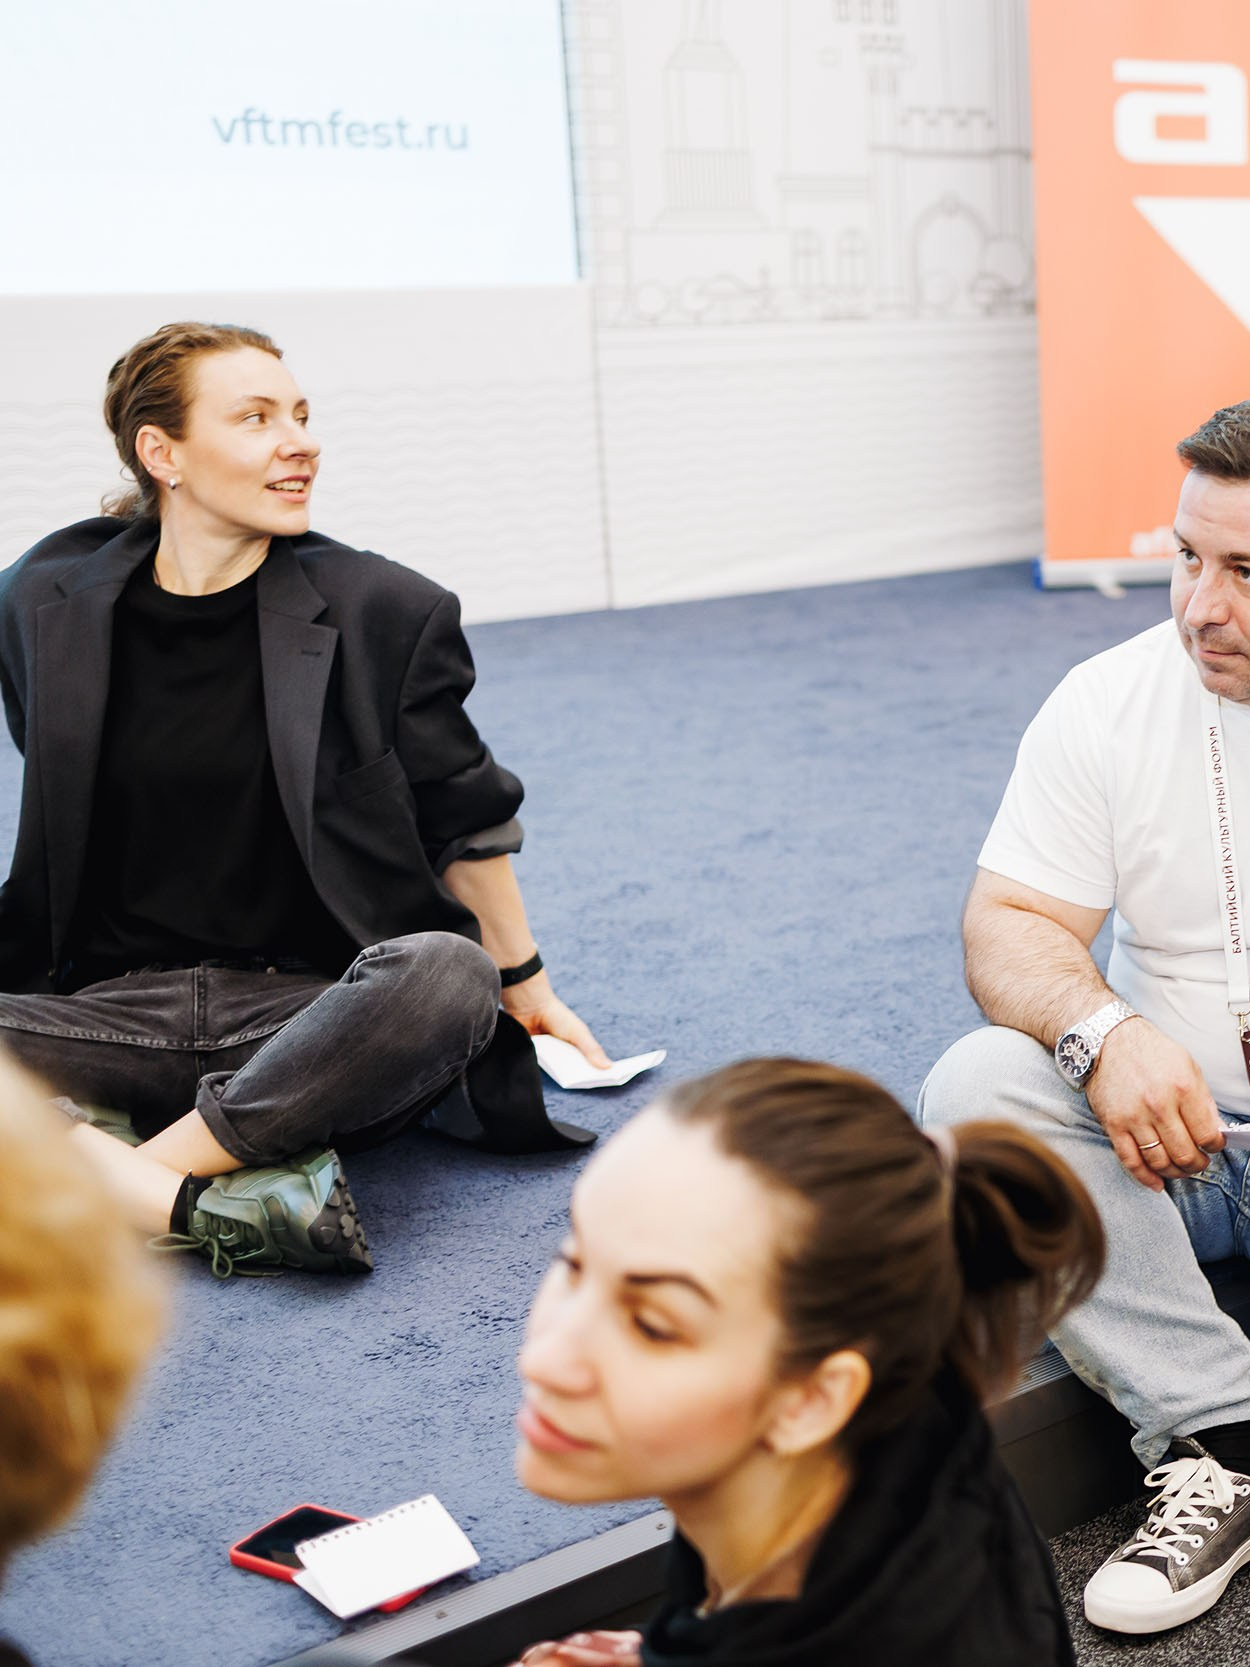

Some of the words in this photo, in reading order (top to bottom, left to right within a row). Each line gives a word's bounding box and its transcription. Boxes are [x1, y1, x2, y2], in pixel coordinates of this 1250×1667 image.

[212, 106, 469, 150] vftmfest.ru
[1209, 726, 1222, 774] ФОРУМ
[1212, 776, 1232, 862] КУЛЬТУРНЫЙ
[1222, 865, 1242, 954] БАЛТИЙСКИЙ
